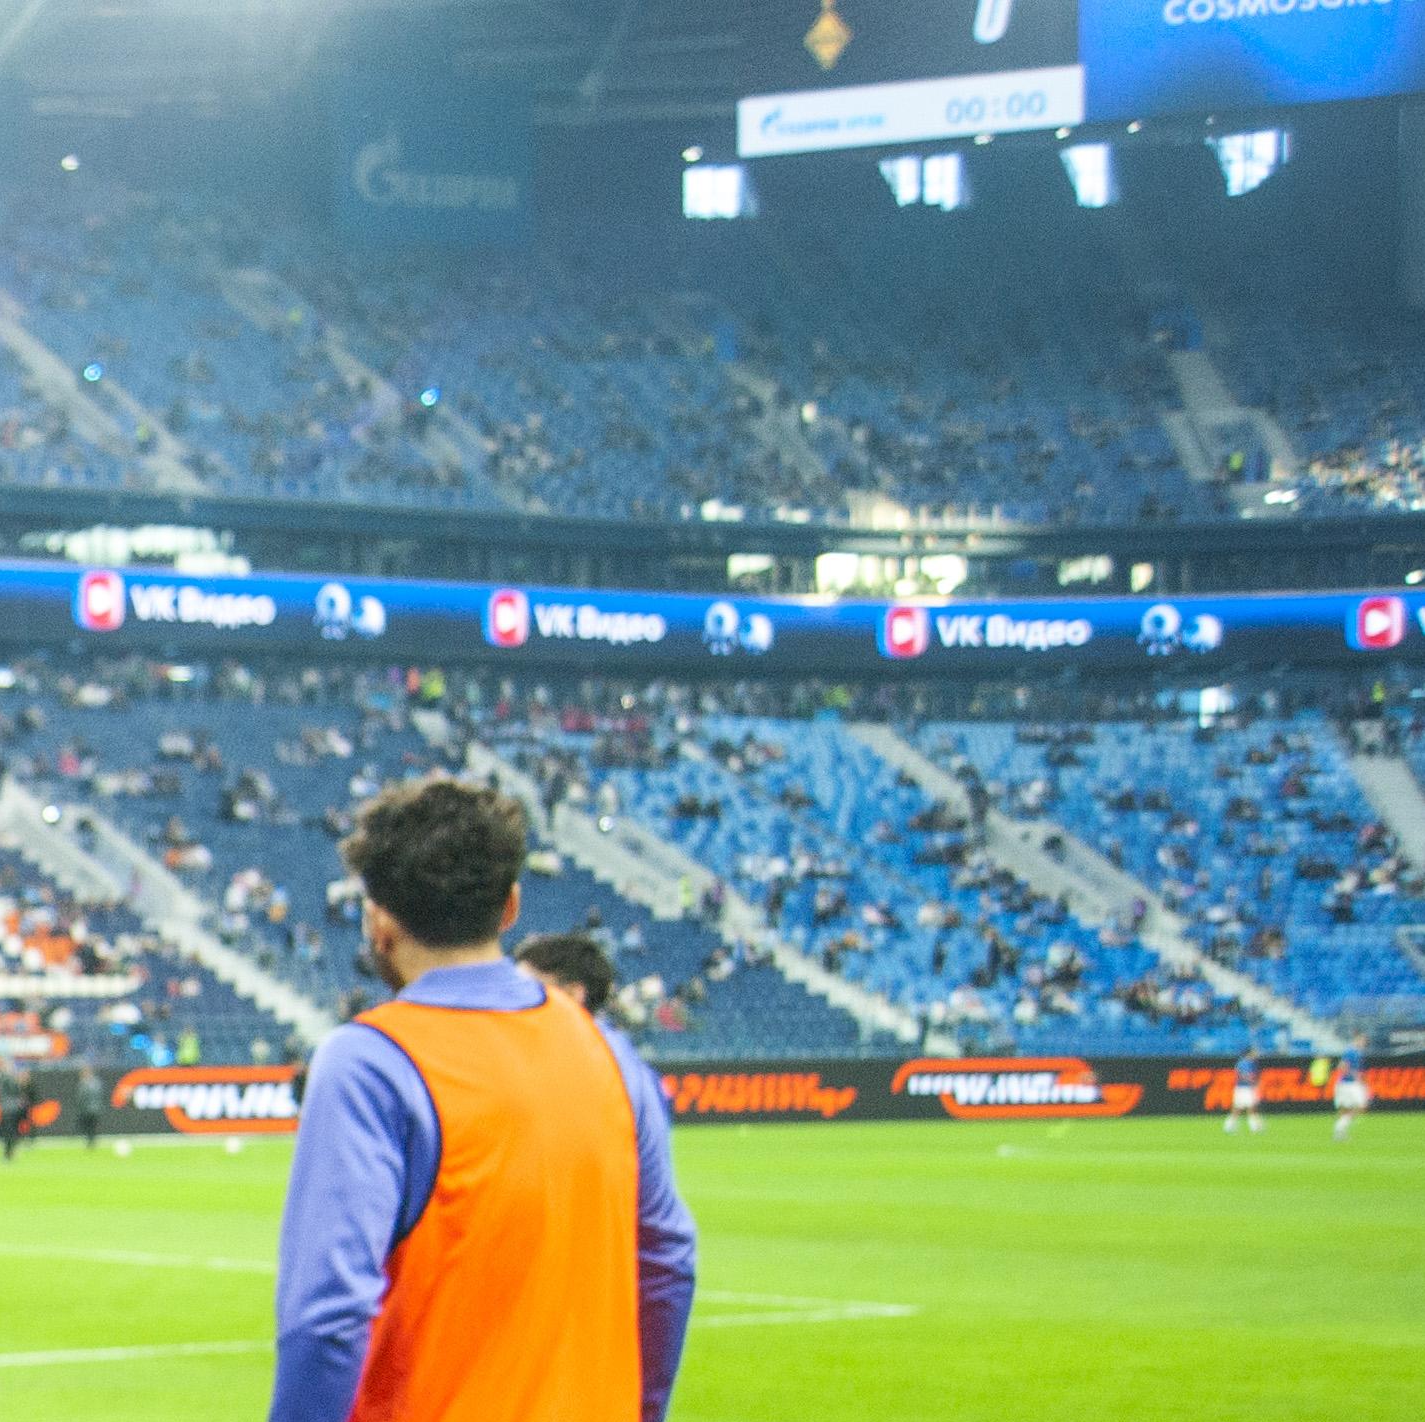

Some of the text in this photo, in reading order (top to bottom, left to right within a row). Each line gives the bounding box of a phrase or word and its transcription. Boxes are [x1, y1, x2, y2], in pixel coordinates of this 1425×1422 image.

[946, 90, 1048, 124] 00:00
[129, 584, 277, 629] VK Видео
[533, 603, 667, 646] VK Видео
[935, 614, 1092, 651] VK Видео
